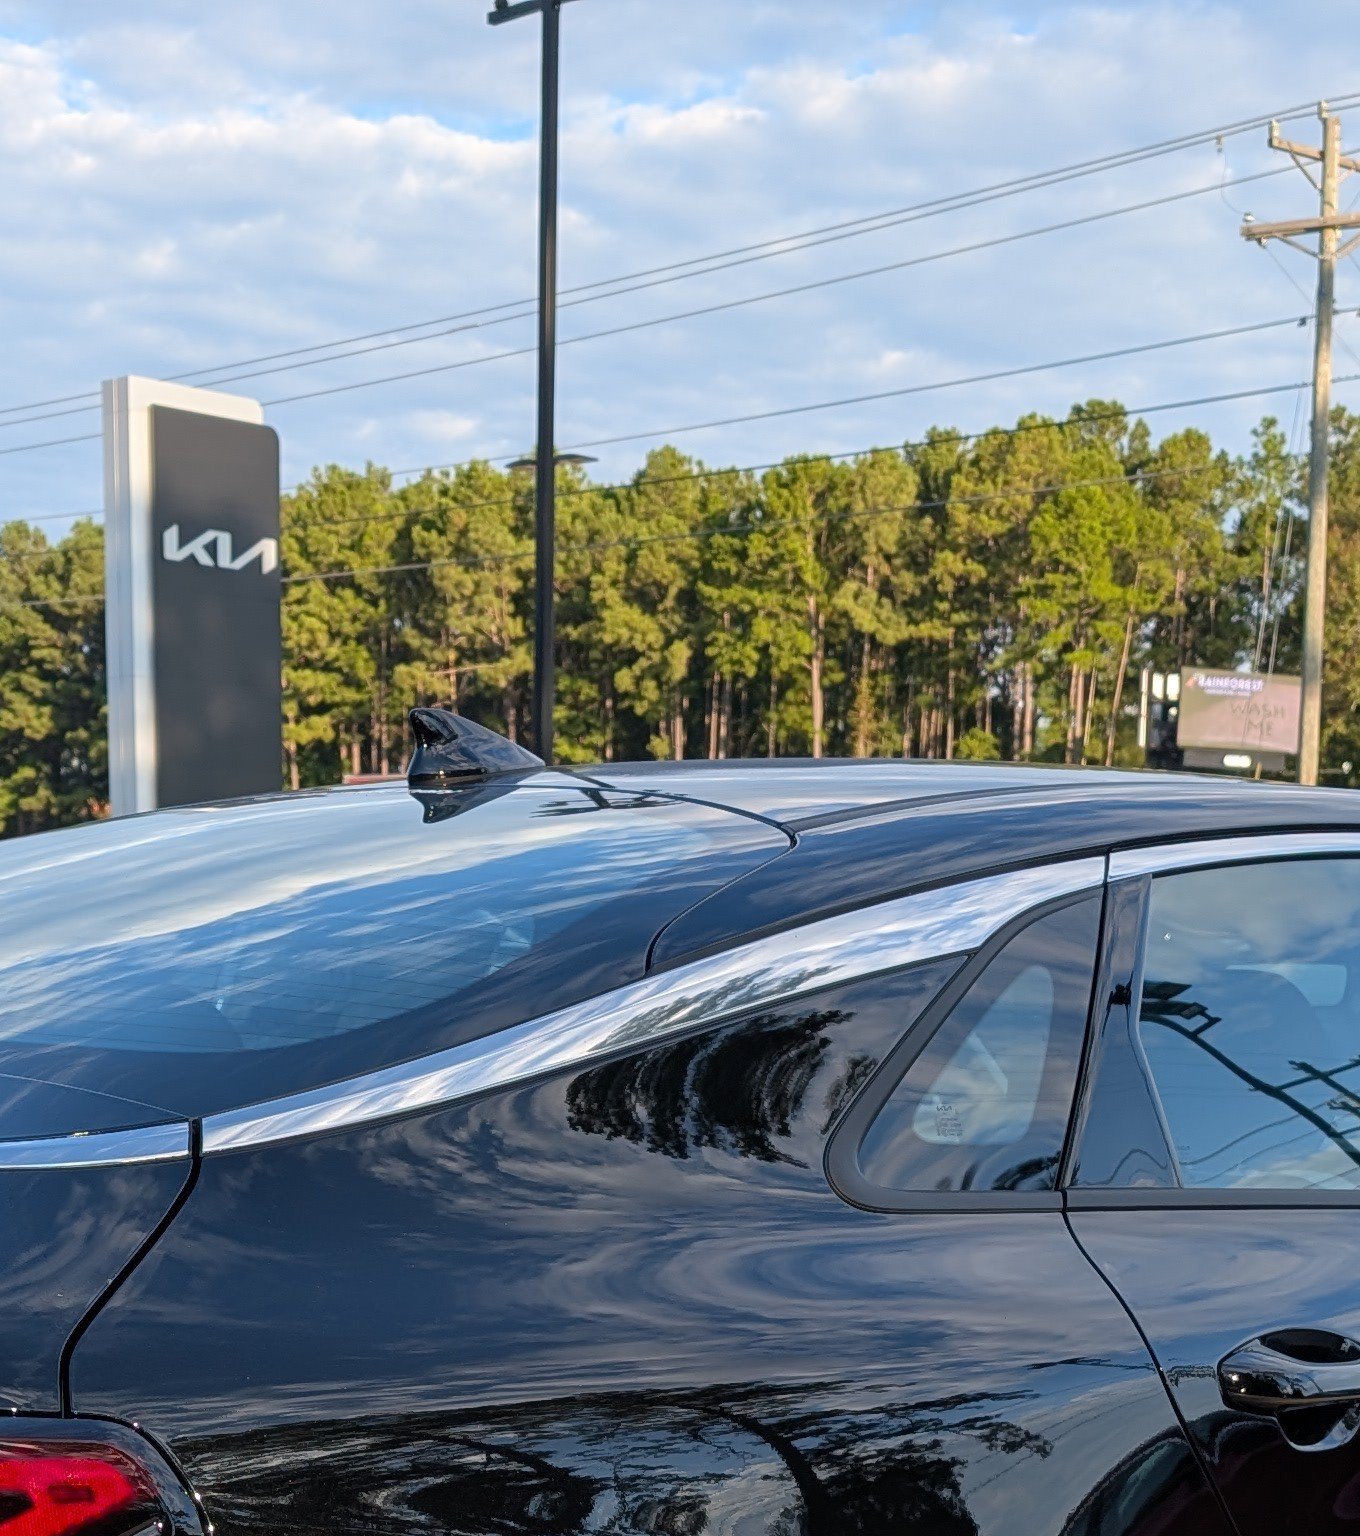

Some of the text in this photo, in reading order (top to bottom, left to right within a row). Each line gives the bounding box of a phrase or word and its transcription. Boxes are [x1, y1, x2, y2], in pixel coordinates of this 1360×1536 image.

[163, 523, 278, 575] KIA
[1230, 701, 1285, 718] WASH
[1246, 719, 1274, 738] ME
